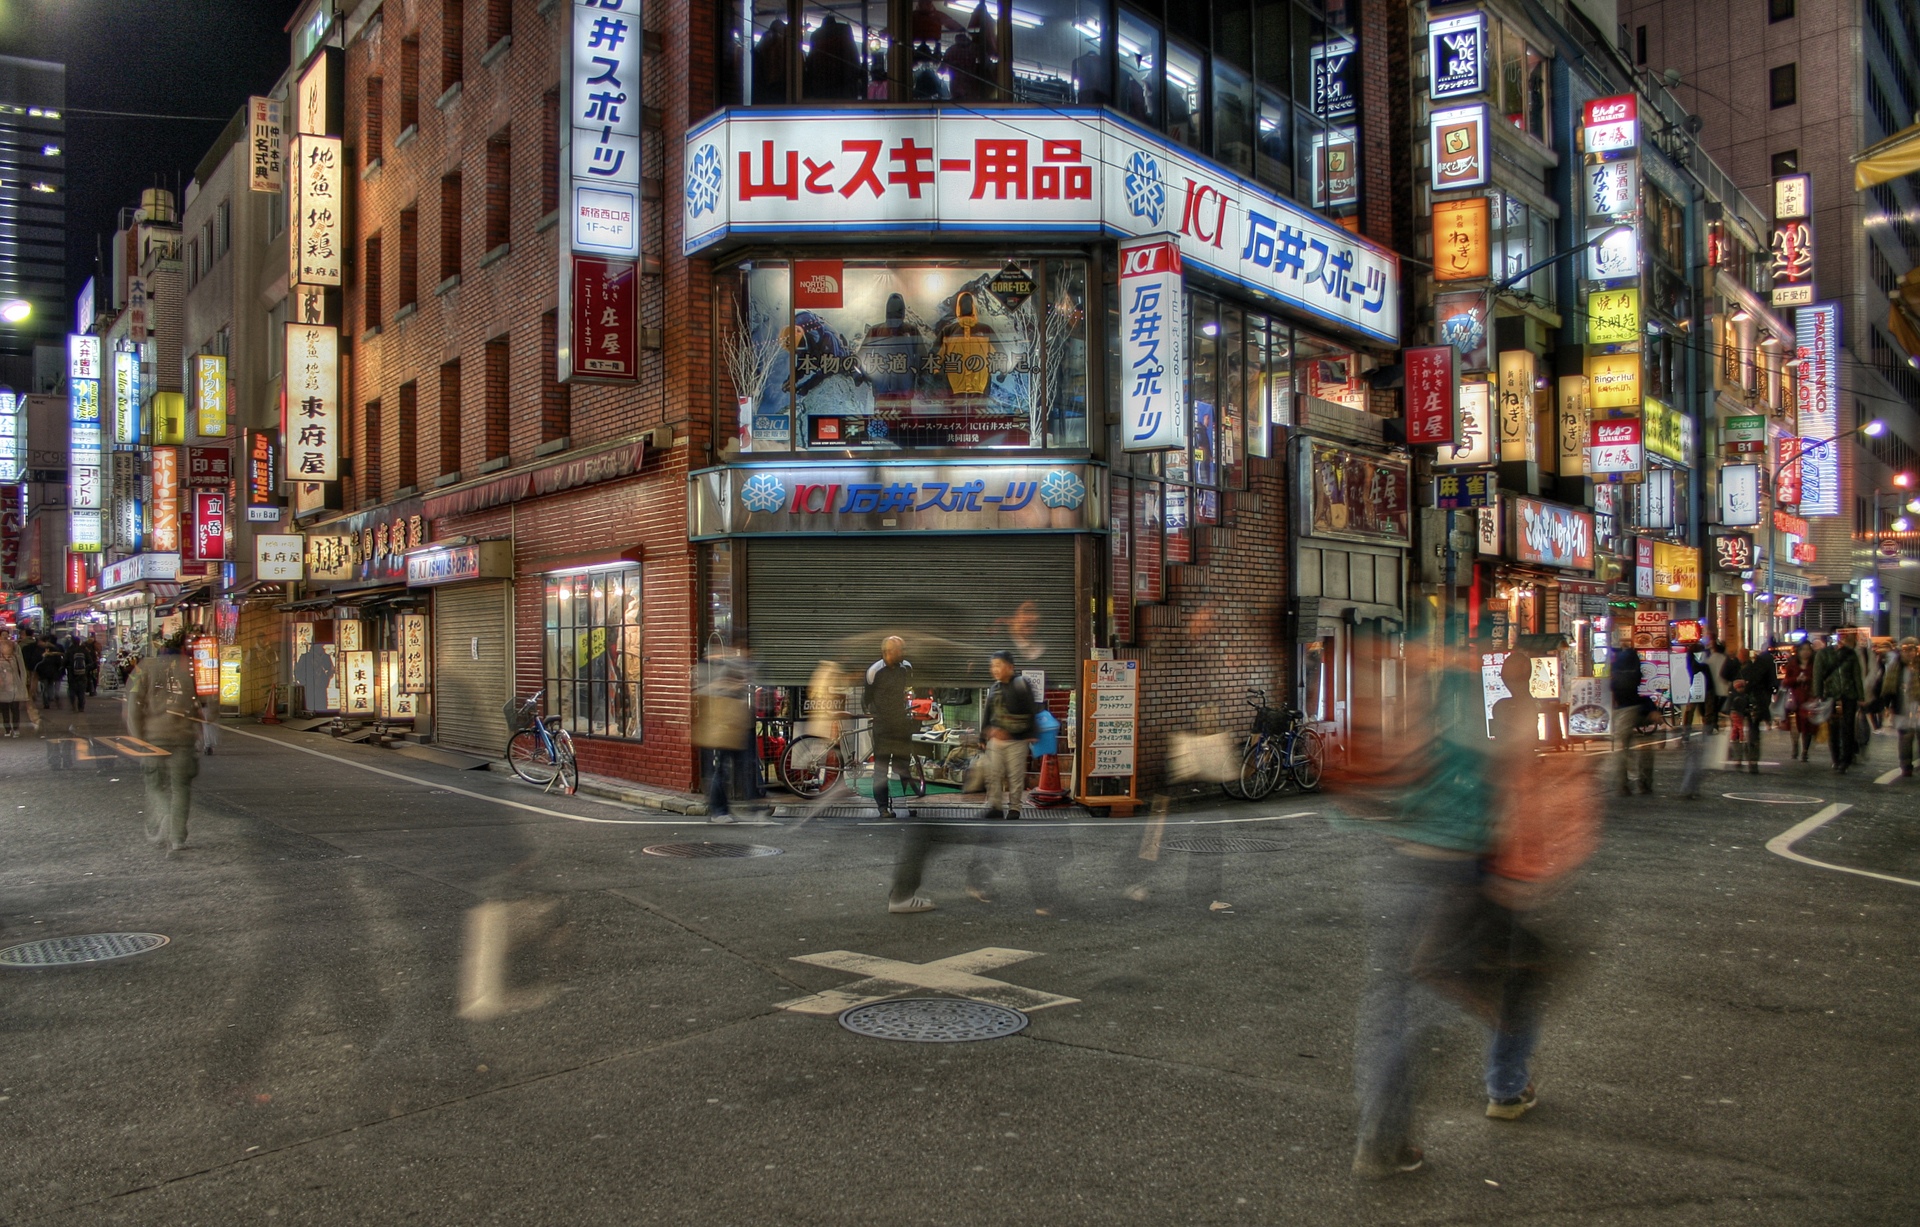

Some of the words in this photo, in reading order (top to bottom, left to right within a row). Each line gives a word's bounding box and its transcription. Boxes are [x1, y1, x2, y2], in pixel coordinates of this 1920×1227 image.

[1443, 34, 1475, 50] VAN
[1459, 48, 1474, 60] DE
[1449, 62, 1475, 76] RAS
[1592, 104, 1626, 117] とんかつ
[255, 125, 269, 180] 川名式典
[738, 138, 1092, 201] 山とスキー用品
[1616, 163, 1628, 201] 居酒屋
[580, 206, 630, 222] 新宿西口店
[1178, 176, 1241, 250] ICI
[1241, 208, 1387, 315] 石井スポーツ
[1123, 246, 1165, 274] ICI
[991, 281, 1030, 292] GORE-TEX
[1776, 290, 1808, 302] 4F受付
[1597, 293, 1631, 311] 焼肉
[601, 306, 621, 355] 庄屋
[80, 340, 90, 376] 大井歯科
[797, 352, 1042, 376] 本物の快適、本当の満足。
[1129, 283, 1164, 441] 石井スポーツ
[1814, 311, 1827, 413] PACHINKO
[1422, 357, 1431, 391] さかな
[1594, 374, 1619, 384] Ringer
[1621, 373, 1635, 381] Hut
[1799, 362, 1811, 413] SLOT
[770, 420, 785, 429] ICI
[1423, 391, 1443, 438] 庄屋
[1501, 390, 1520, 437] ねぎし
[205, 425, 221, 433] 3F
[298, 395, 327, 475] 東府屋
[947, 434, 979, 442] 共同開発
[1561, 411, 1578, 452] ねぎし
[1598, 426, 1632, 436] とんかつ
[255, 432, 268, 459] Bar
[1738, 443, 1752, 451] B1
[193, 459, 227, 473] 印章
[80, 468, 91, 505] コンドル
[254, 461, 268, 503] THREE
[1439, 475, 1485, 497] 麻雀
[789, 483, 841, 514] ICI
[839, 479, 1037, 514] 石井スポーツ
[1471, 498, 1486, 506] 5F
[1524, 503, 1587, 558] さぬき小町うどん
[260, 552, 300, 562] 東府屋
[274, 567, 287, 575] 5F
[354, 669, 368, 709] 東府屋
[804, 699, 844, 710] GREGORY
